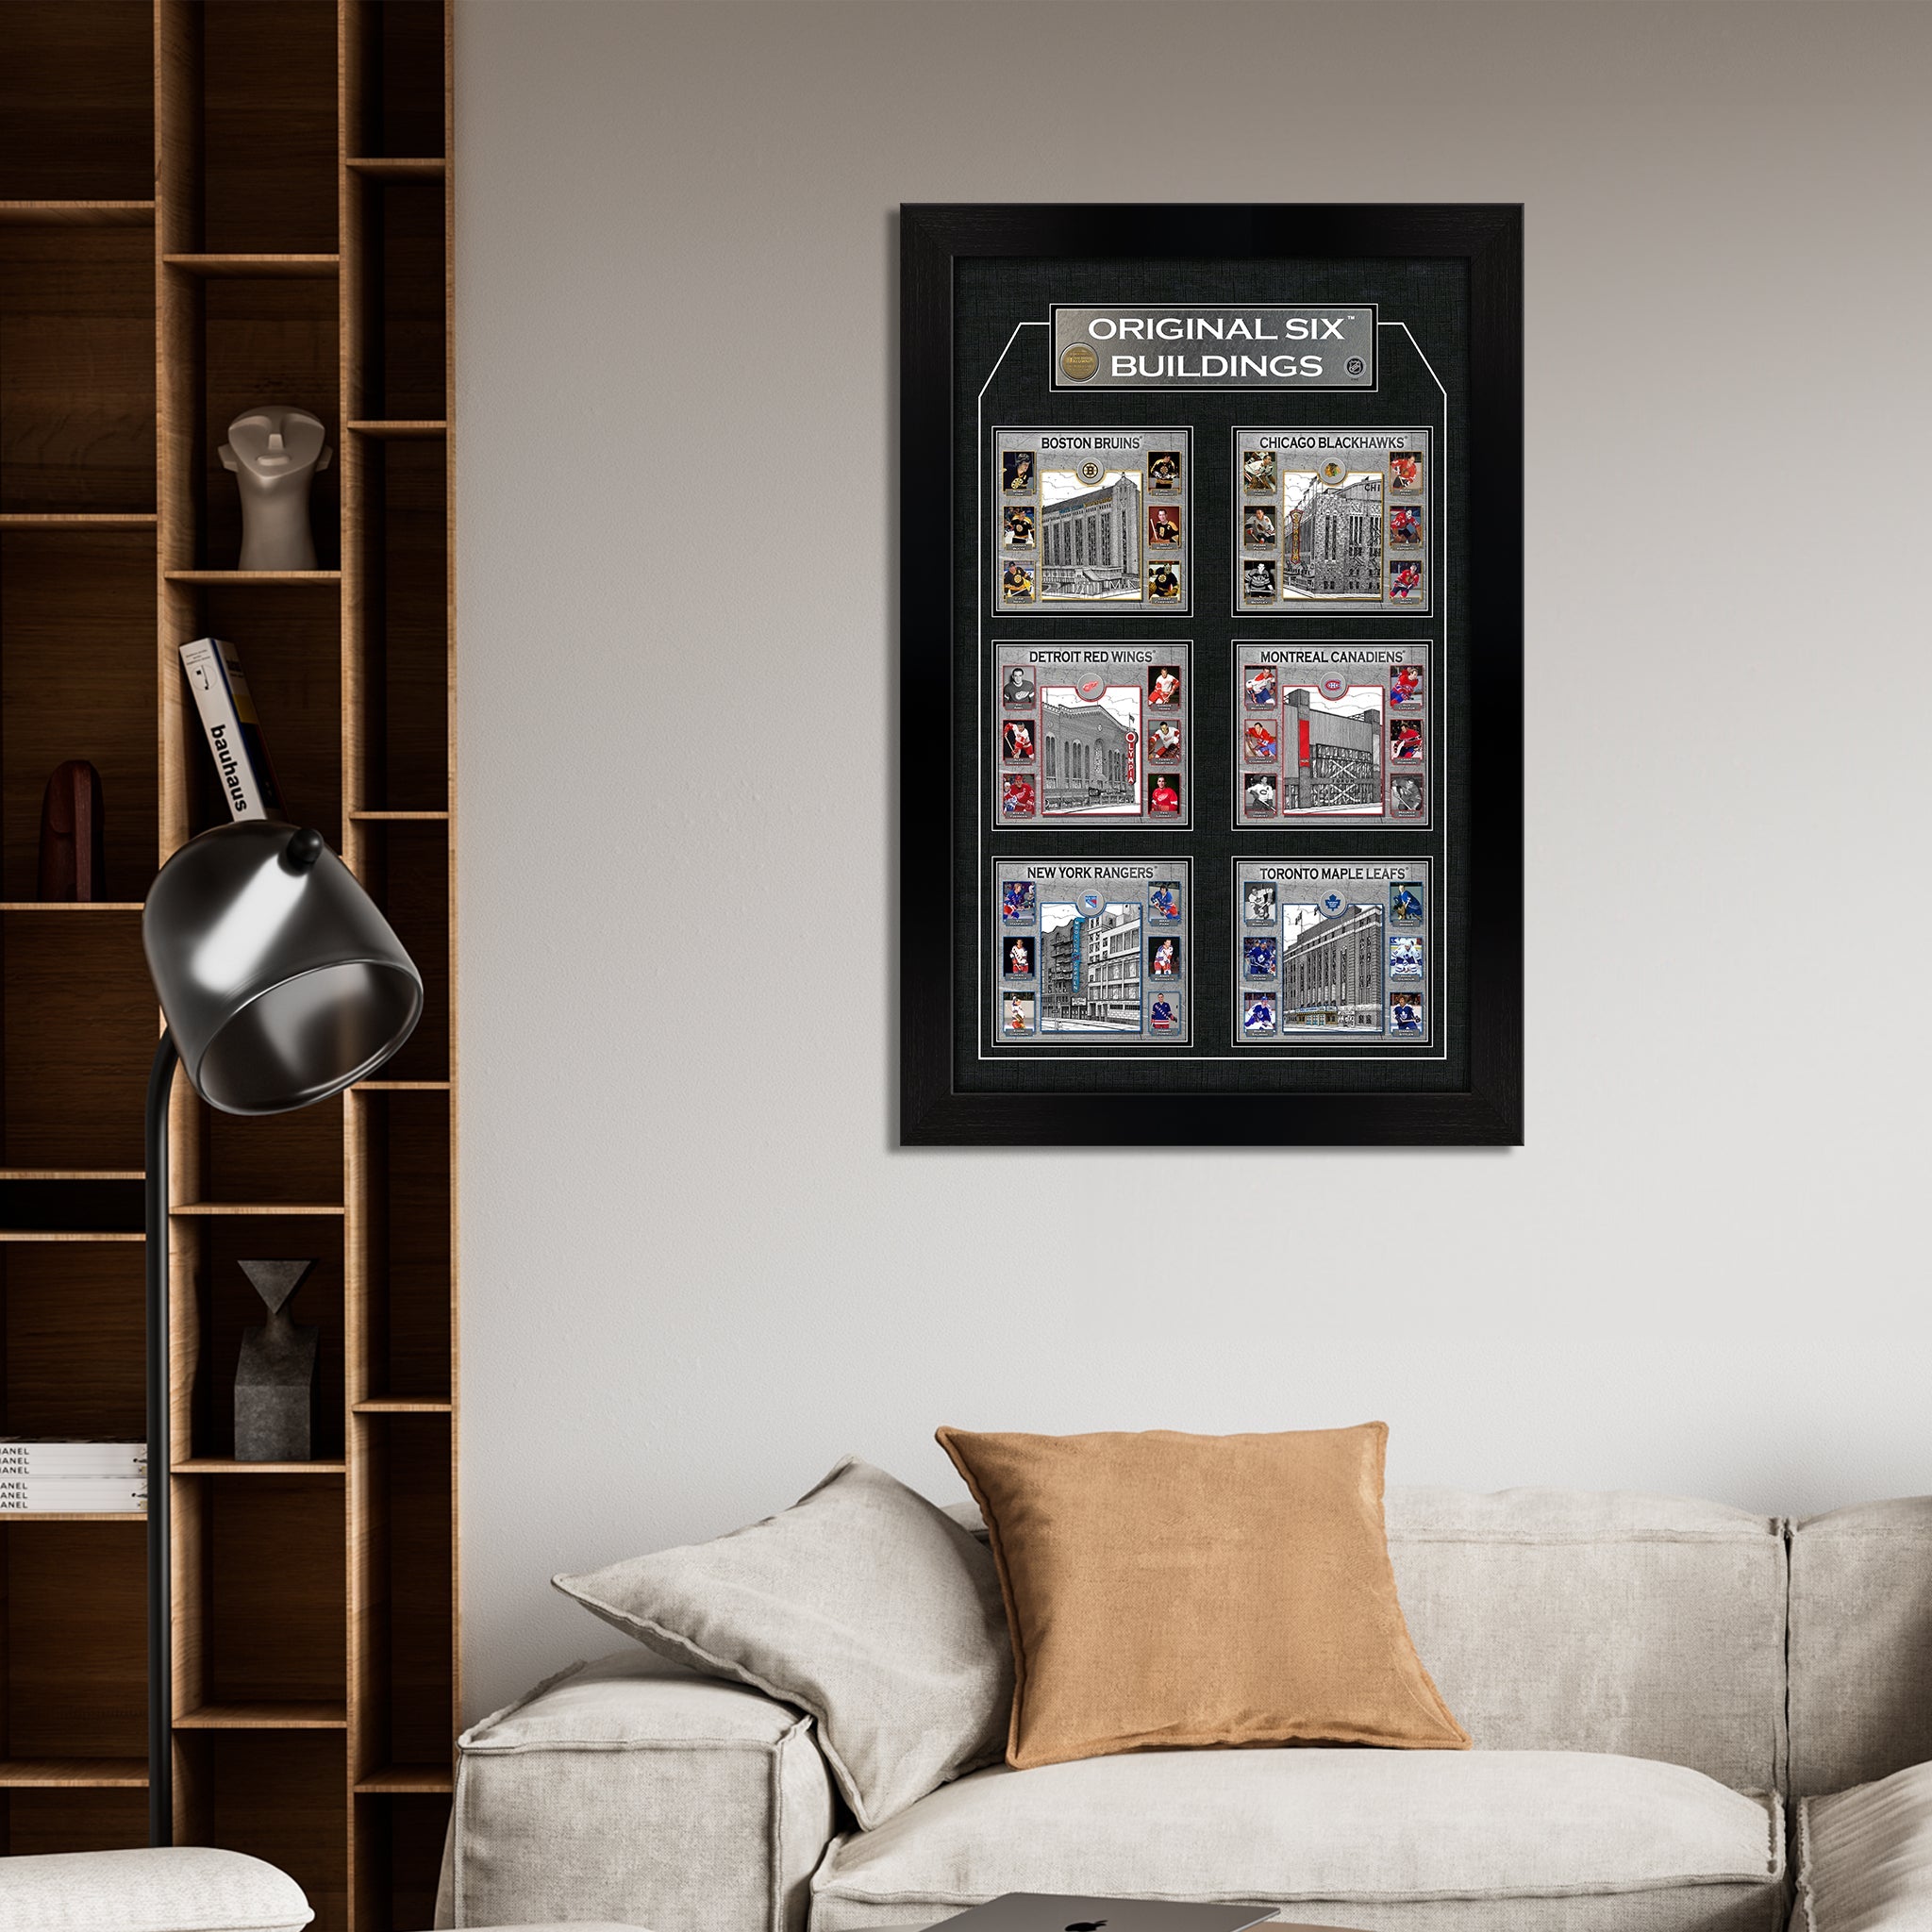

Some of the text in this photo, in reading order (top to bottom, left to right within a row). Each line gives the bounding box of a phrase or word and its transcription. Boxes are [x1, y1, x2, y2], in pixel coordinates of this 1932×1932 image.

[1088, 317, 1278, 340] ORIGINAL
[1111, 355, 1323, 377] BUILDINGS
[1041, 437, 1141, 449] BOSTON BRUINS
[1259, 437, 1405, 449] CHICAGO BLACKHAWKS
[1029, 651, 1153, 663] DETROIT RED WINGS
[1260, 651, 1403, 663] MONTREAL CANADIENS
[1125, 732, 1136, 783] OLYMPIA
[209, 724, 248, 813] bauhaus
[1027, 867, 1154, 879] NEW YORK RANGERS
[1260, 868, 1406, 880] TORONTO MAPLE LEAFS
